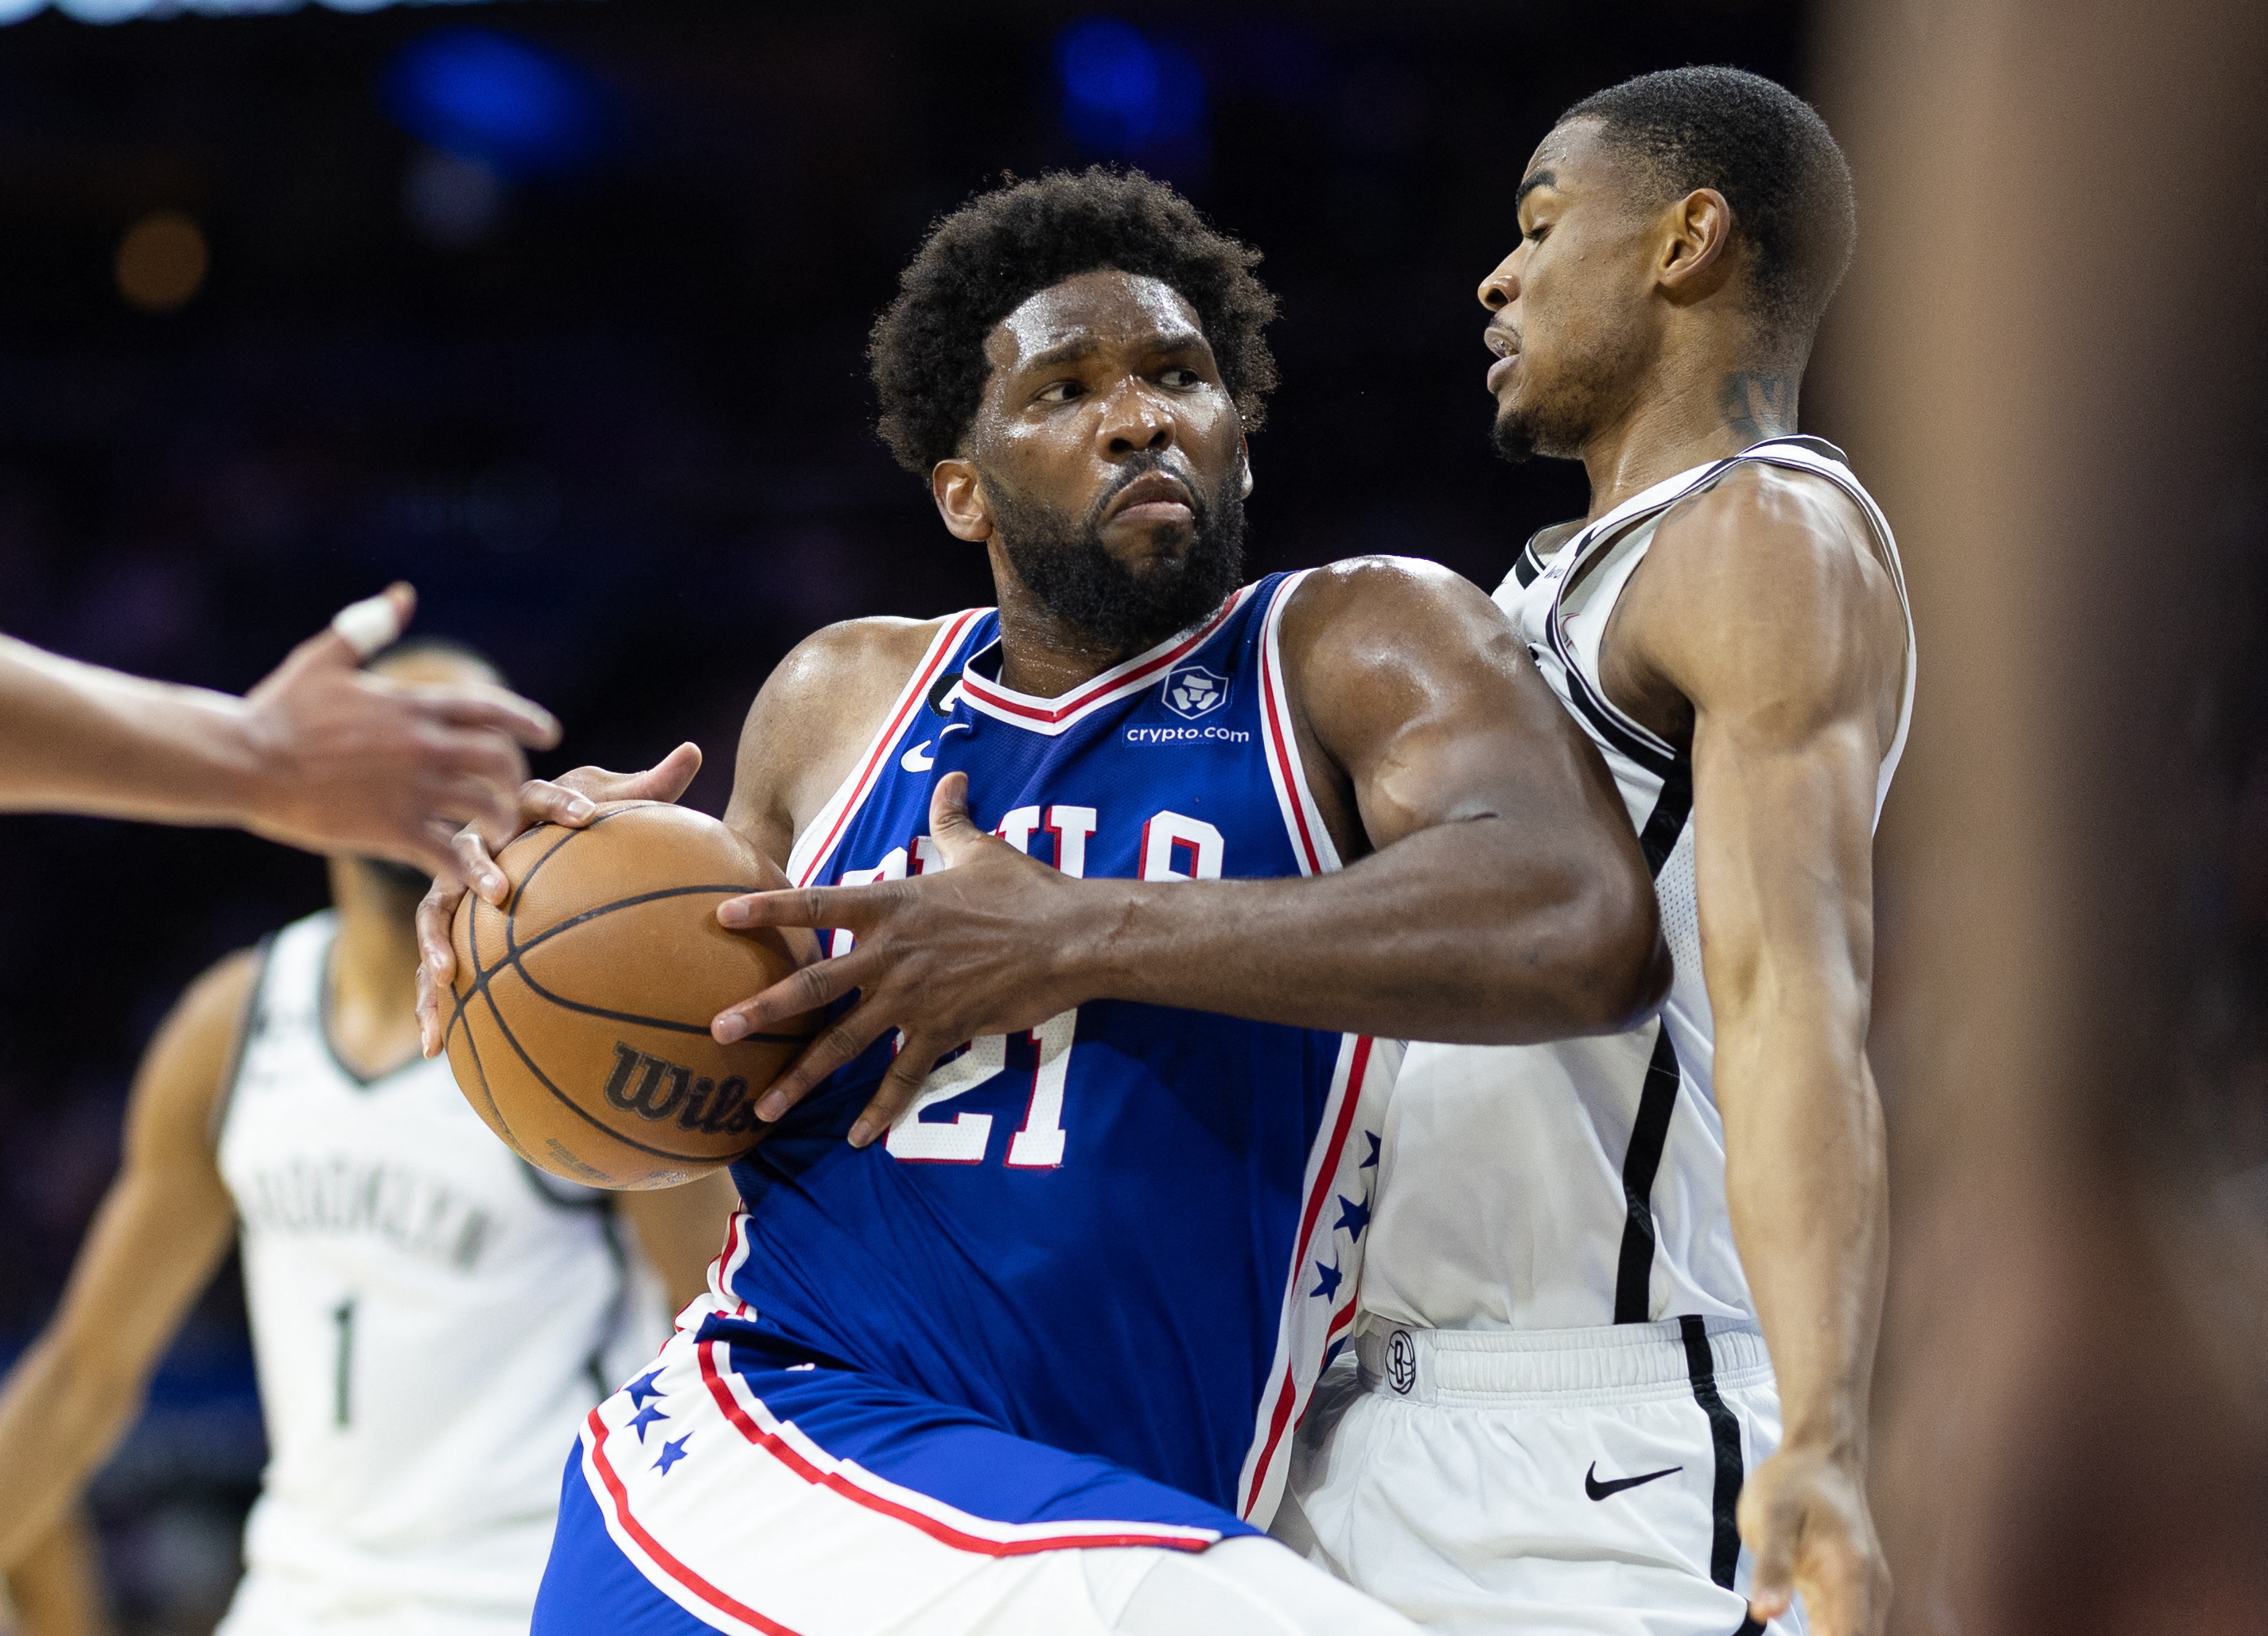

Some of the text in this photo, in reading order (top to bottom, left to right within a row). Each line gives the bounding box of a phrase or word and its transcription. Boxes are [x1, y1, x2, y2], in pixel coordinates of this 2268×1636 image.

[1126, 726, 1250, 743] crypto.com
[604, 1040, 768, 1136] Wils
[882, 1008, 1078, 1168] 21
[326, 1294, 356, 1430] 1
